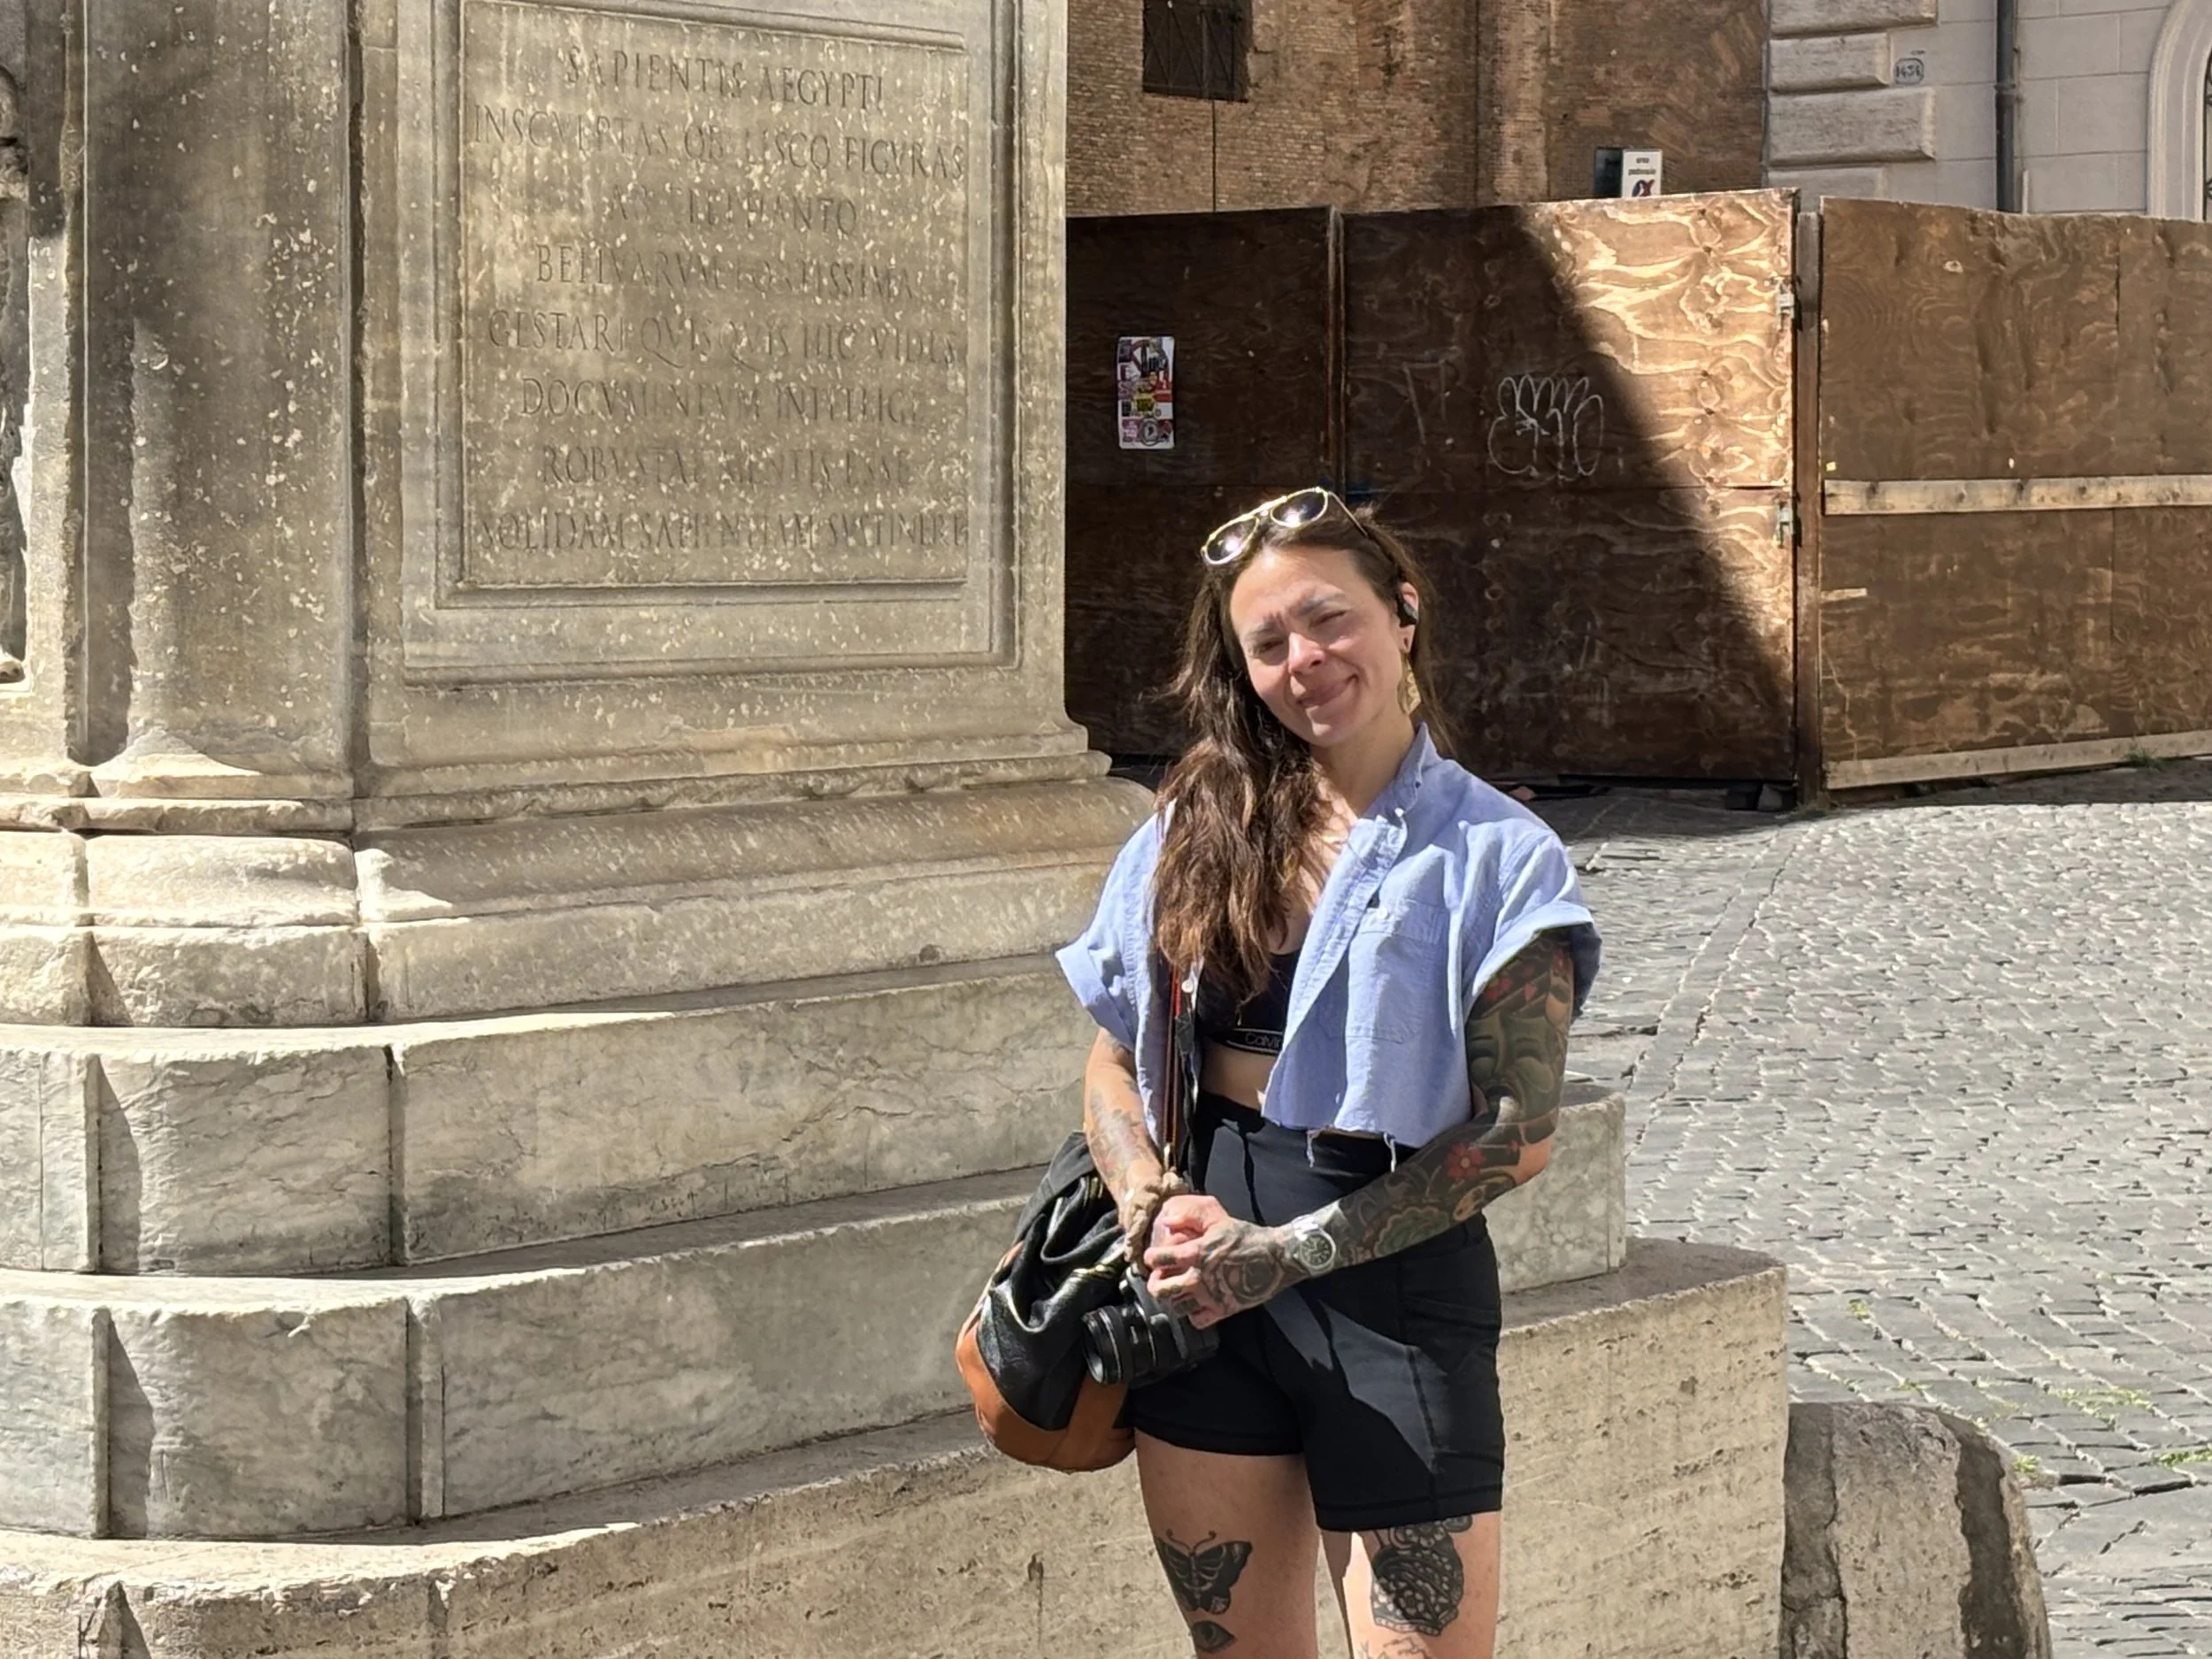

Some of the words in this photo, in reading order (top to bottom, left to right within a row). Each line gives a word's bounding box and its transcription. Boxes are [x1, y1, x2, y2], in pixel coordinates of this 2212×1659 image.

[565, 46, 744, 98] SAPIENTIS
[758, 66, 883, 111] AEGYPTI
[473, 104, 669, 156] INSCVLPTAS
[684, 125, 831, 170] OBLISCO
[845, 135, 964, 180] FIGVRAS
[667, 184, 857, 235] LEPHANTO
[488, 310, 625, 352] GESTARI
[480, 511, 626, 549] SOLIDAM
